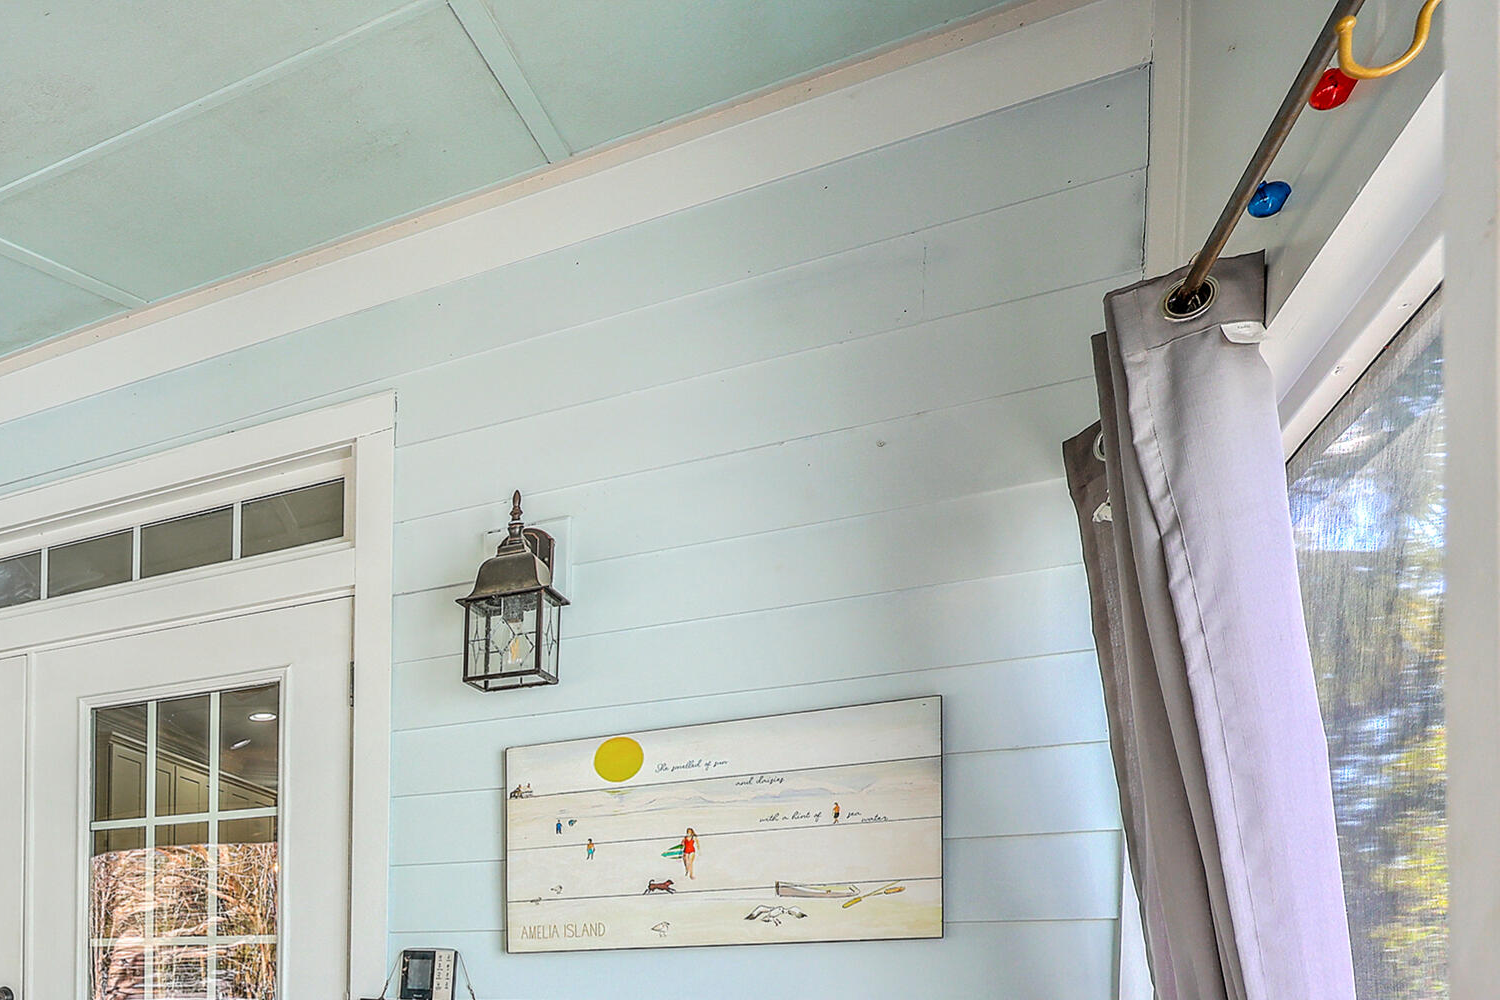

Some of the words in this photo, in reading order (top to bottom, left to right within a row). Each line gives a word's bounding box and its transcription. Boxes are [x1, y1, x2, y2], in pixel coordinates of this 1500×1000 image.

[704, 760, 712, 771] of
[735, 776, 753, 786] and
[760, 812, 780, 823] with
[791, 810, 810, 820] hint
[813, 811, 822, 822] of
[861, 814, 889, 823] water
[521, 924, 560, 939] AMELIA
[563, 922, 606, 938] ISLAND
